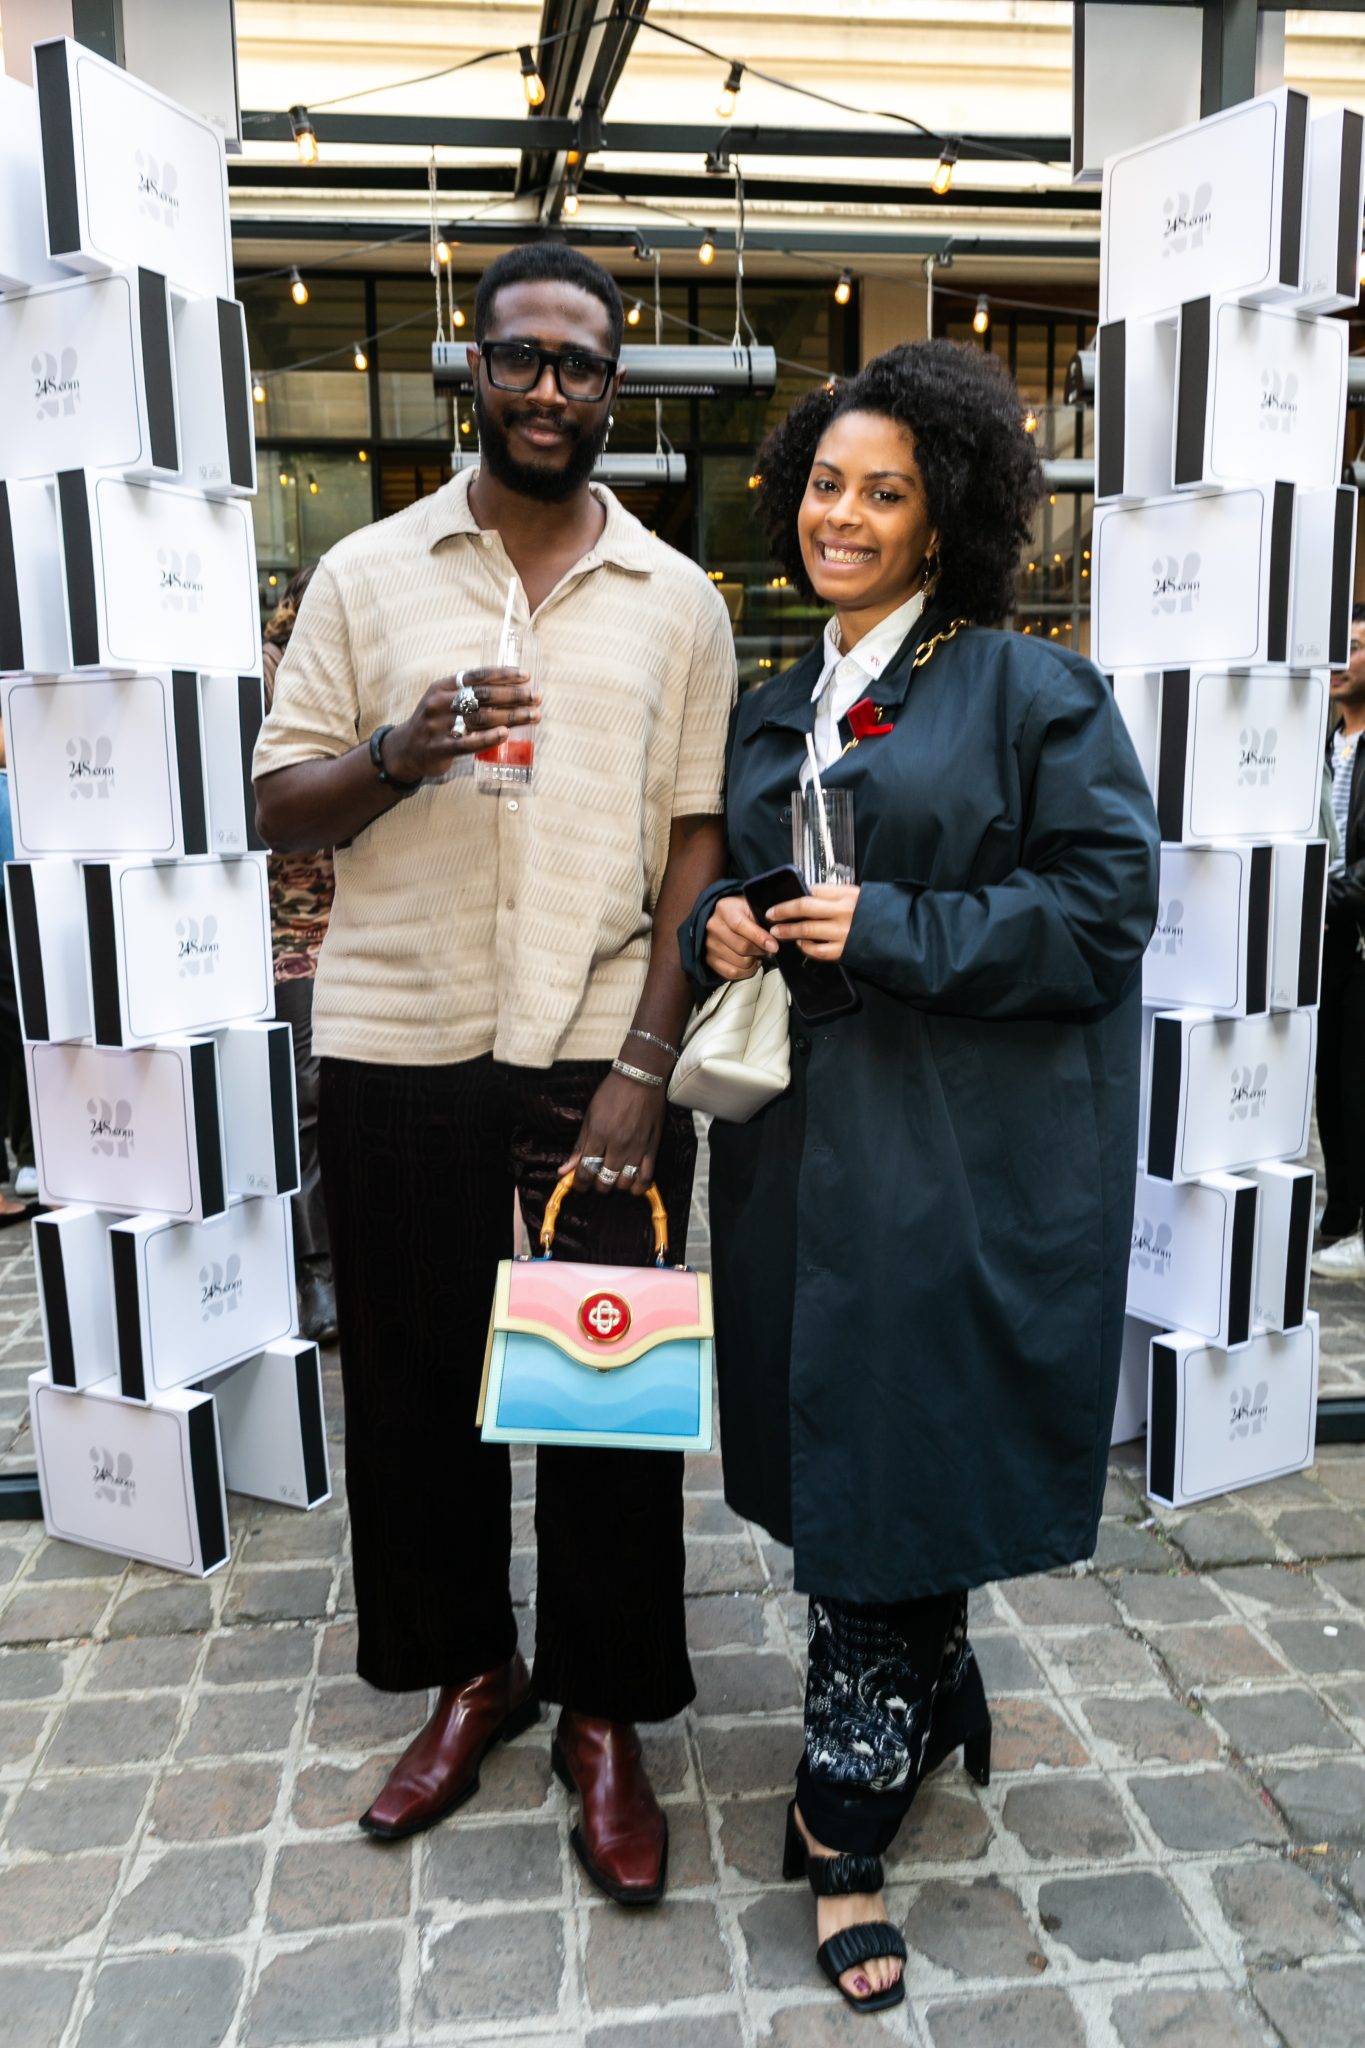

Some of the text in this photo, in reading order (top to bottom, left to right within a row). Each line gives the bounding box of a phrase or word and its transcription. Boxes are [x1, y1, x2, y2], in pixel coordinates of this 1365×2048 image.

[1162, 211, 1212, 238] 24S.com
[35, 378, 80, 397] 24S.com
[159, 571, 203, 592] 24S.com
[1152, 577, 1200, 595] 24S.com
[1239, 750, 1276, 767] 24S.com
[68, 761, 114, 778] 24S.com
[177, 940, 219, 958] 24S.com
[1230, 1085, 1267, 1104] 24S.com
[90, 1118, 135, 1138] 24S.com
[201, 1277, 242, 1305] 24S.com
[1231, 1403, 1268, 1423] 24S.com
[92, 1465, 135, 1490] 24S.com
